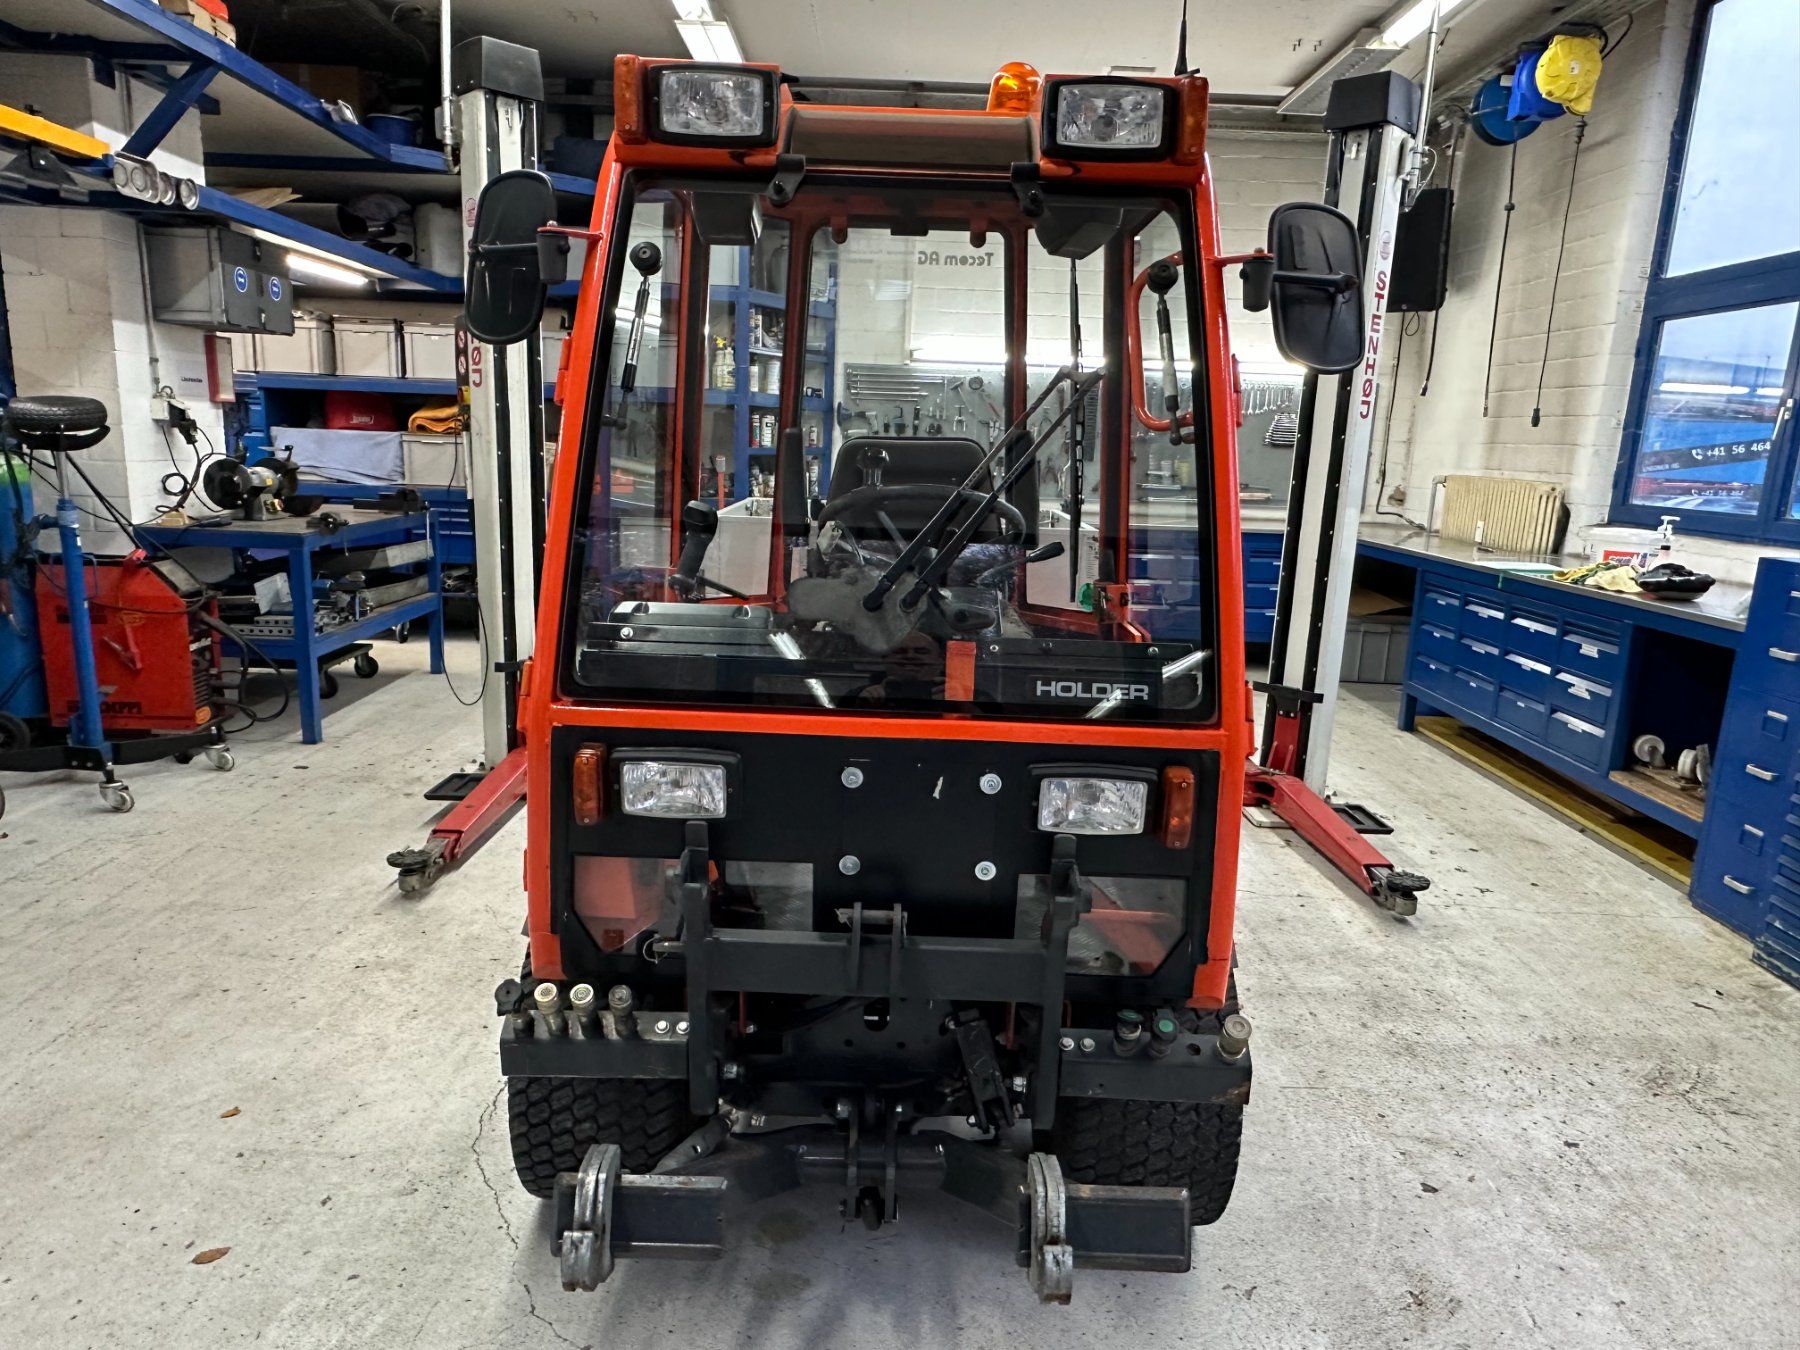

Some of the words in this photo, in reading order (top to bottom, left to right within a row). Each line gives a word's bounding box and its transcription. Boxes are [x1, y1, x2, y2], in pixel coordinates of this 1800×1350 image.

[1360, 270, 1388, 420] STENHØJ
[1706, 446, 1726, 457] +41
[1731, 444, 1746, 455] 56
[1751, 441, 1771, 452] 464
[1036, 680, 1149, 700] HOLDER
